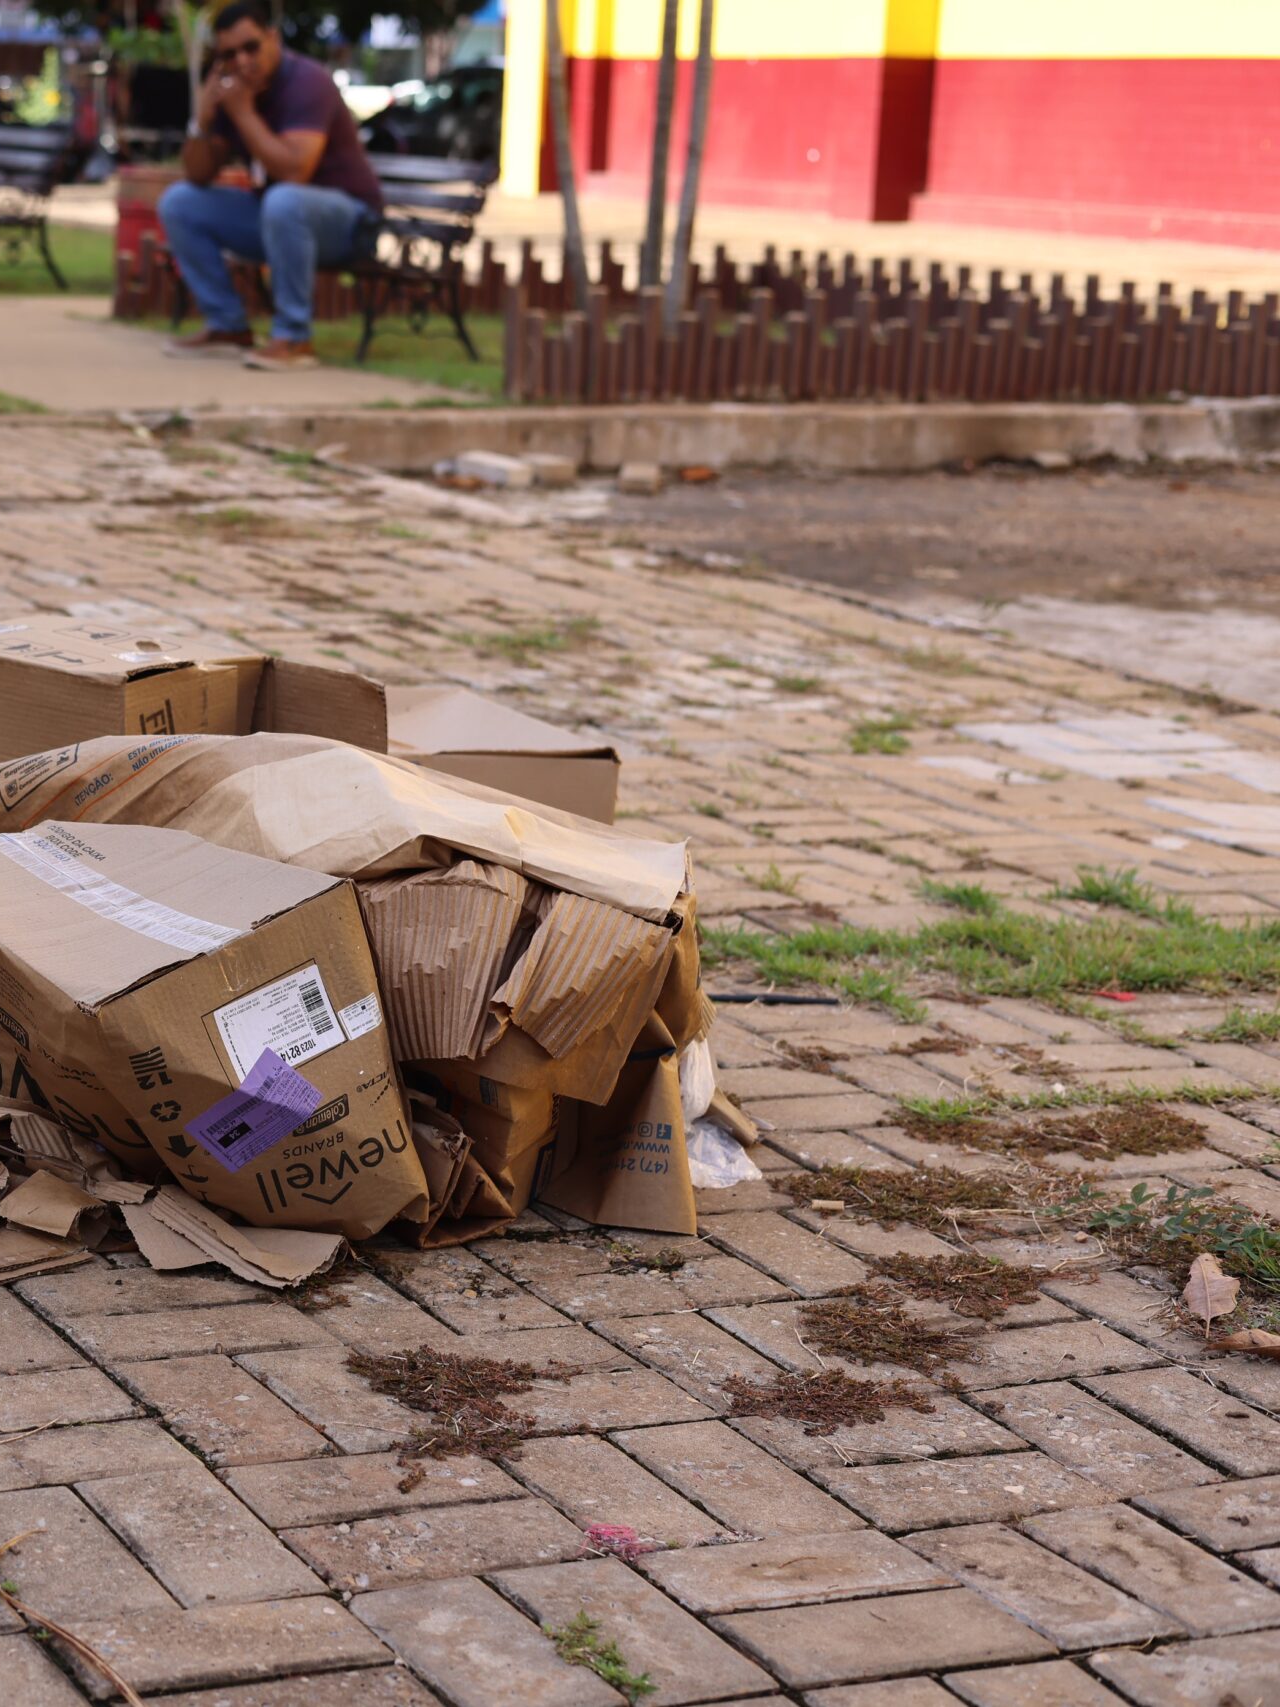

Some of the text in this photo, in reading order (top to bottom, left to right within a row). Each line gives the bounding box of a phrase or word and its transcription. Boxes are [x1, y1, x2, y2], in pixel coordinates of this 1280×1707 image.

[136, 1071, 173, 1090] 12
[283, 1131, 344, 1160] BRANDS
[256, 1119, 408, 1214] newell
[639, 1157, 669, 1175] (47)
